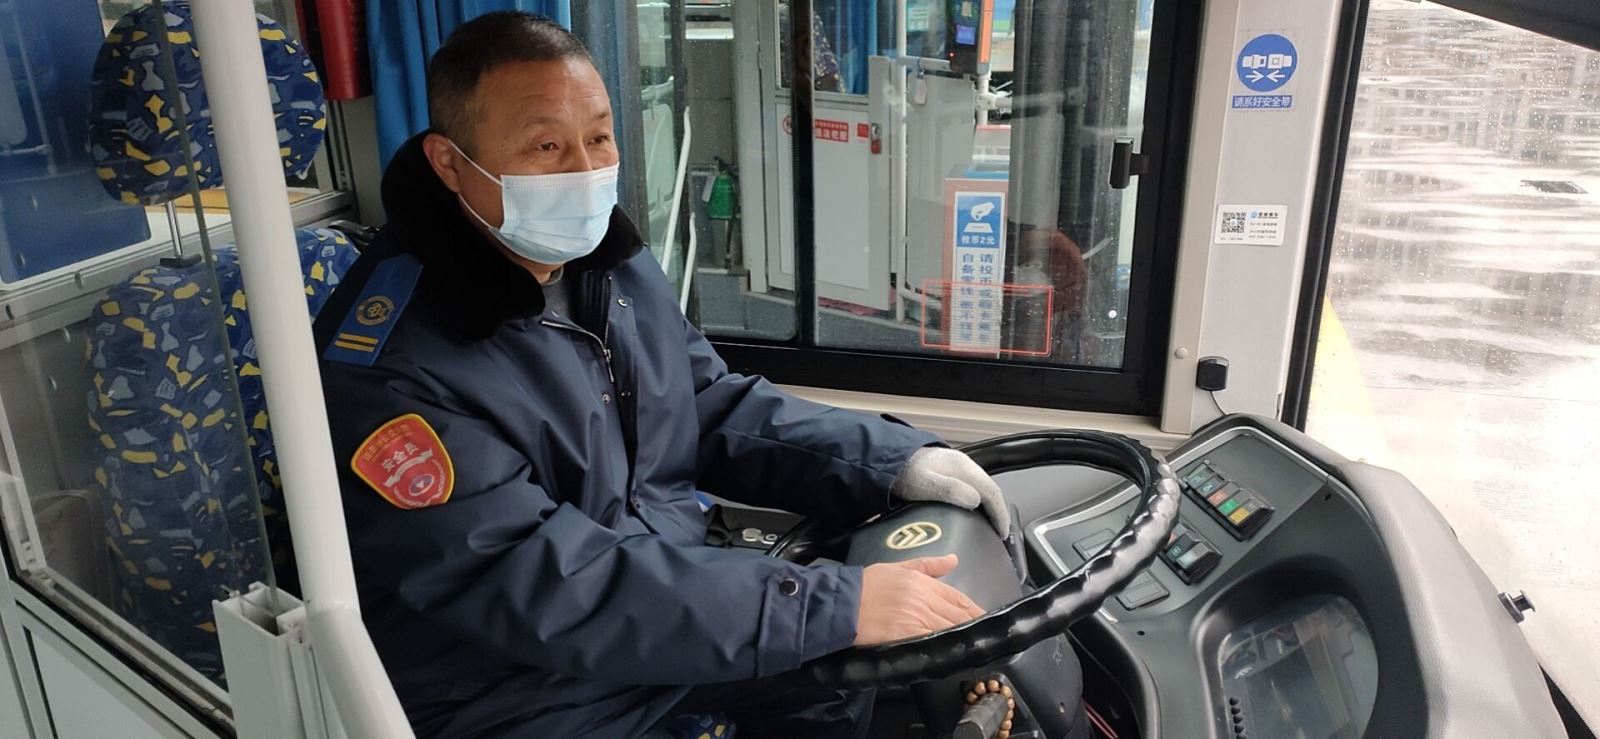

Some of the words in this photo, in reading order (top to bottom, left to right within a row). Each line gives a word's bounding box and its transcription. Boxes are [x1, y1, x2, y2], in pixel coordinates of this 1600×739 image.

[1234, 96, 1291, 108] 请系好安全带
[961, 235, 995, 246] 投币2元
[381, 442, 418, 472] 安全员
